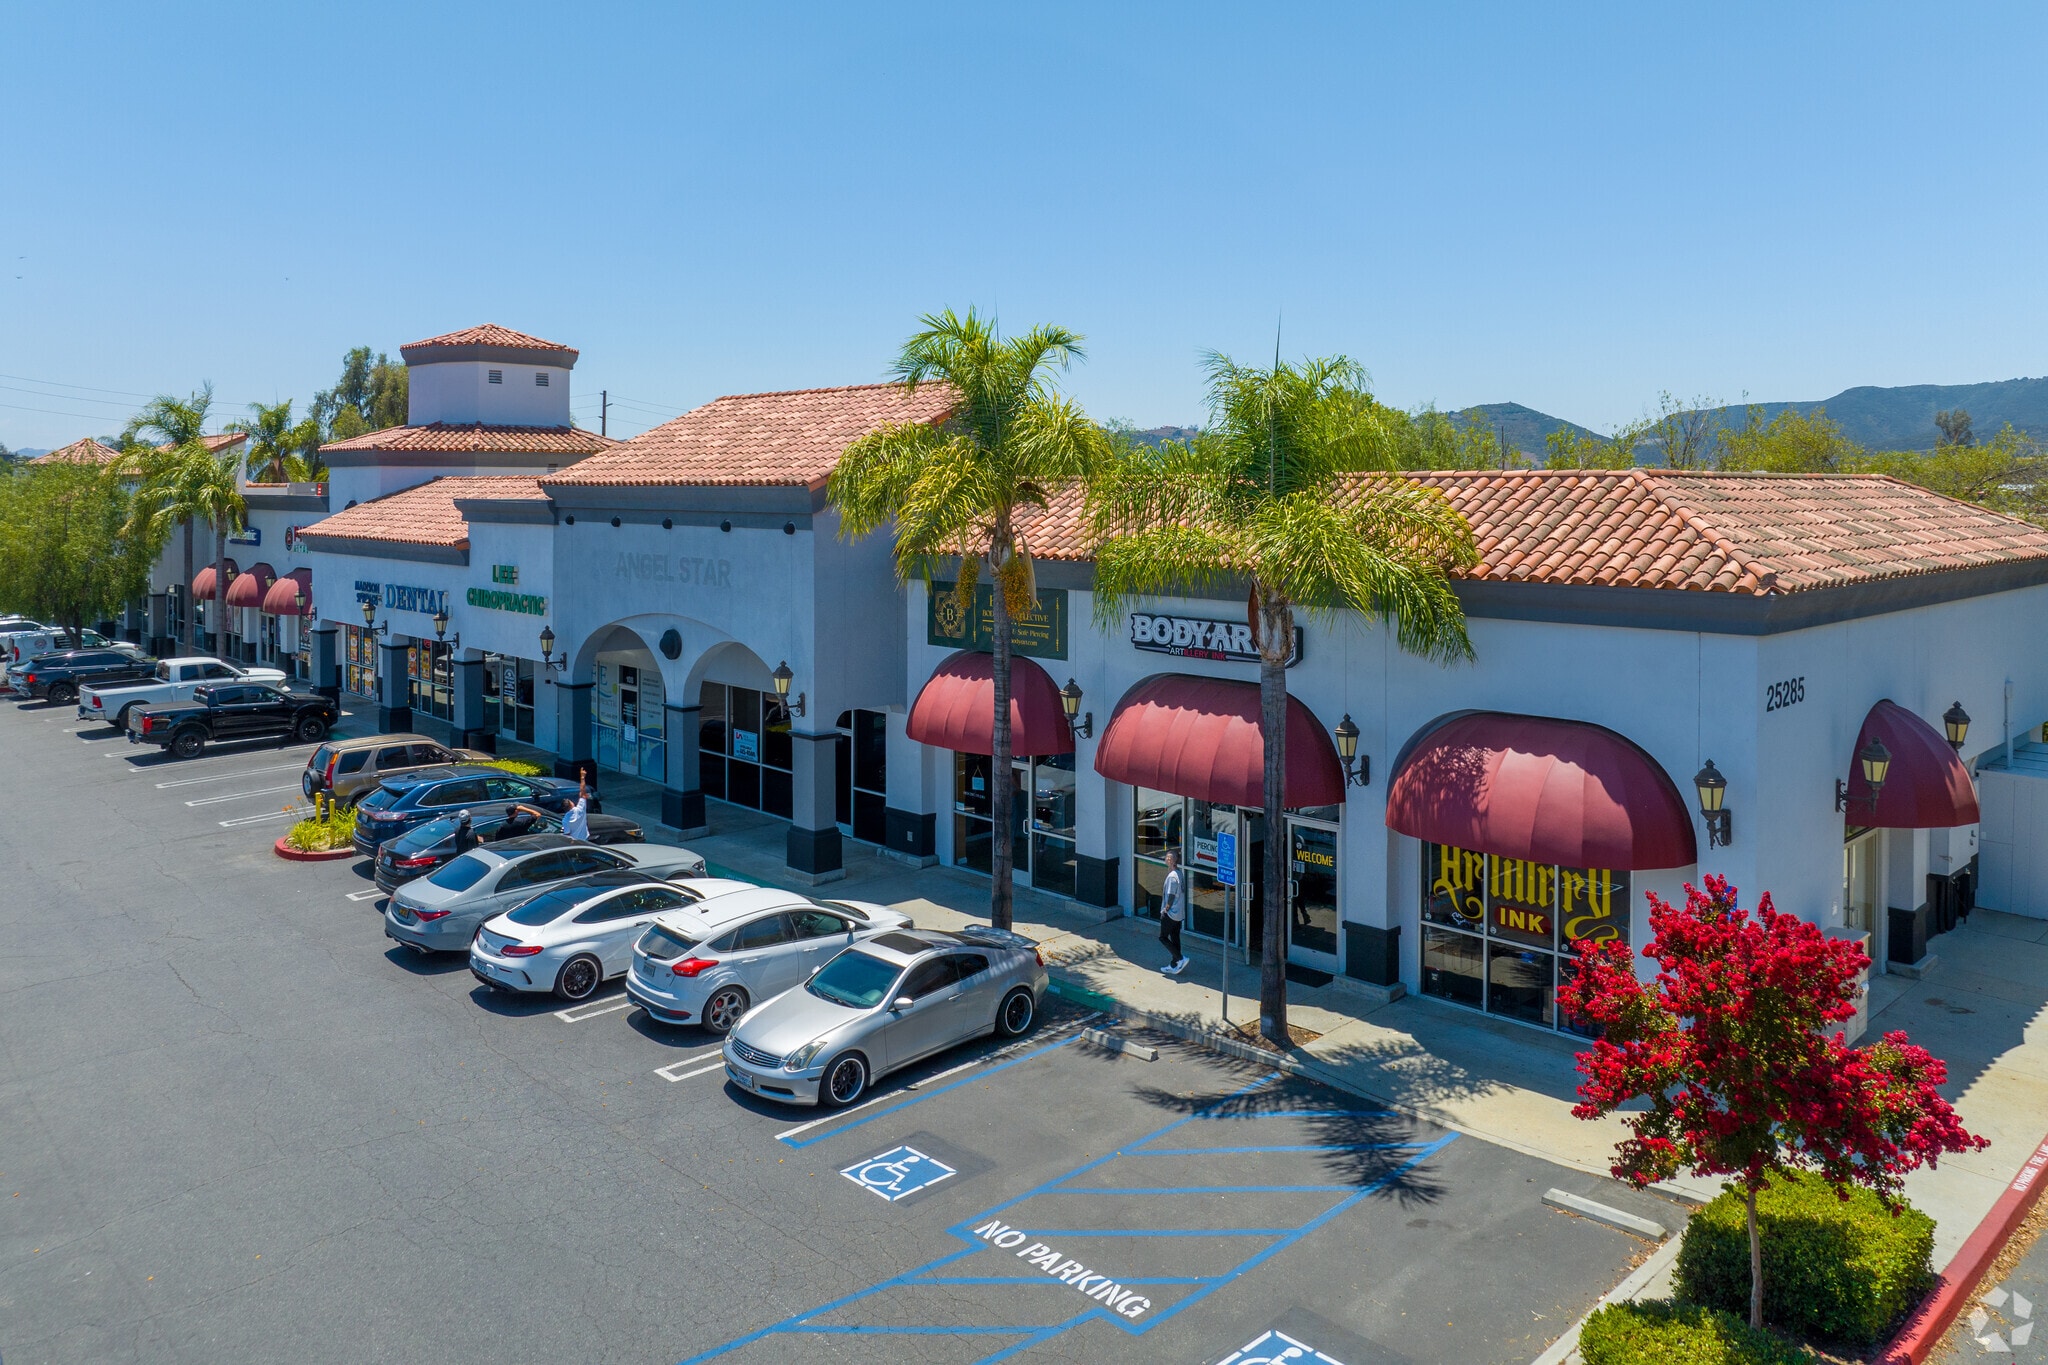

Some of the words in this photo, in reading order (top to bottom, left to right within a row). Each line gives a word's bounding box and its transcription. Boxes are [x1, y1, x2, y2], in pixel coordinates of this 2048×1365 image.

[492, 564, 517, 584] LEE
[615, 552, 675, 583] ANGEL
[679, 557, 732, 588] STAR
[355, 580, 380, 594] MADISON
[385, 583, 449, 616] DENTAL
[467, 587, 545, 616] CHIROPRACTIC
[1169, 647, 1209, 659] ARTILLERY
[1211, 650, 1227, 661] INK
[1766, 676, 1805, 712] 25285
[1296, 849, 1334, 867] WELCOME
[1499, 907, 1545, 935] INK
[973, 1220, 1027, 1248] NO
[1015, 1242, 1151, 1318] PARKING
